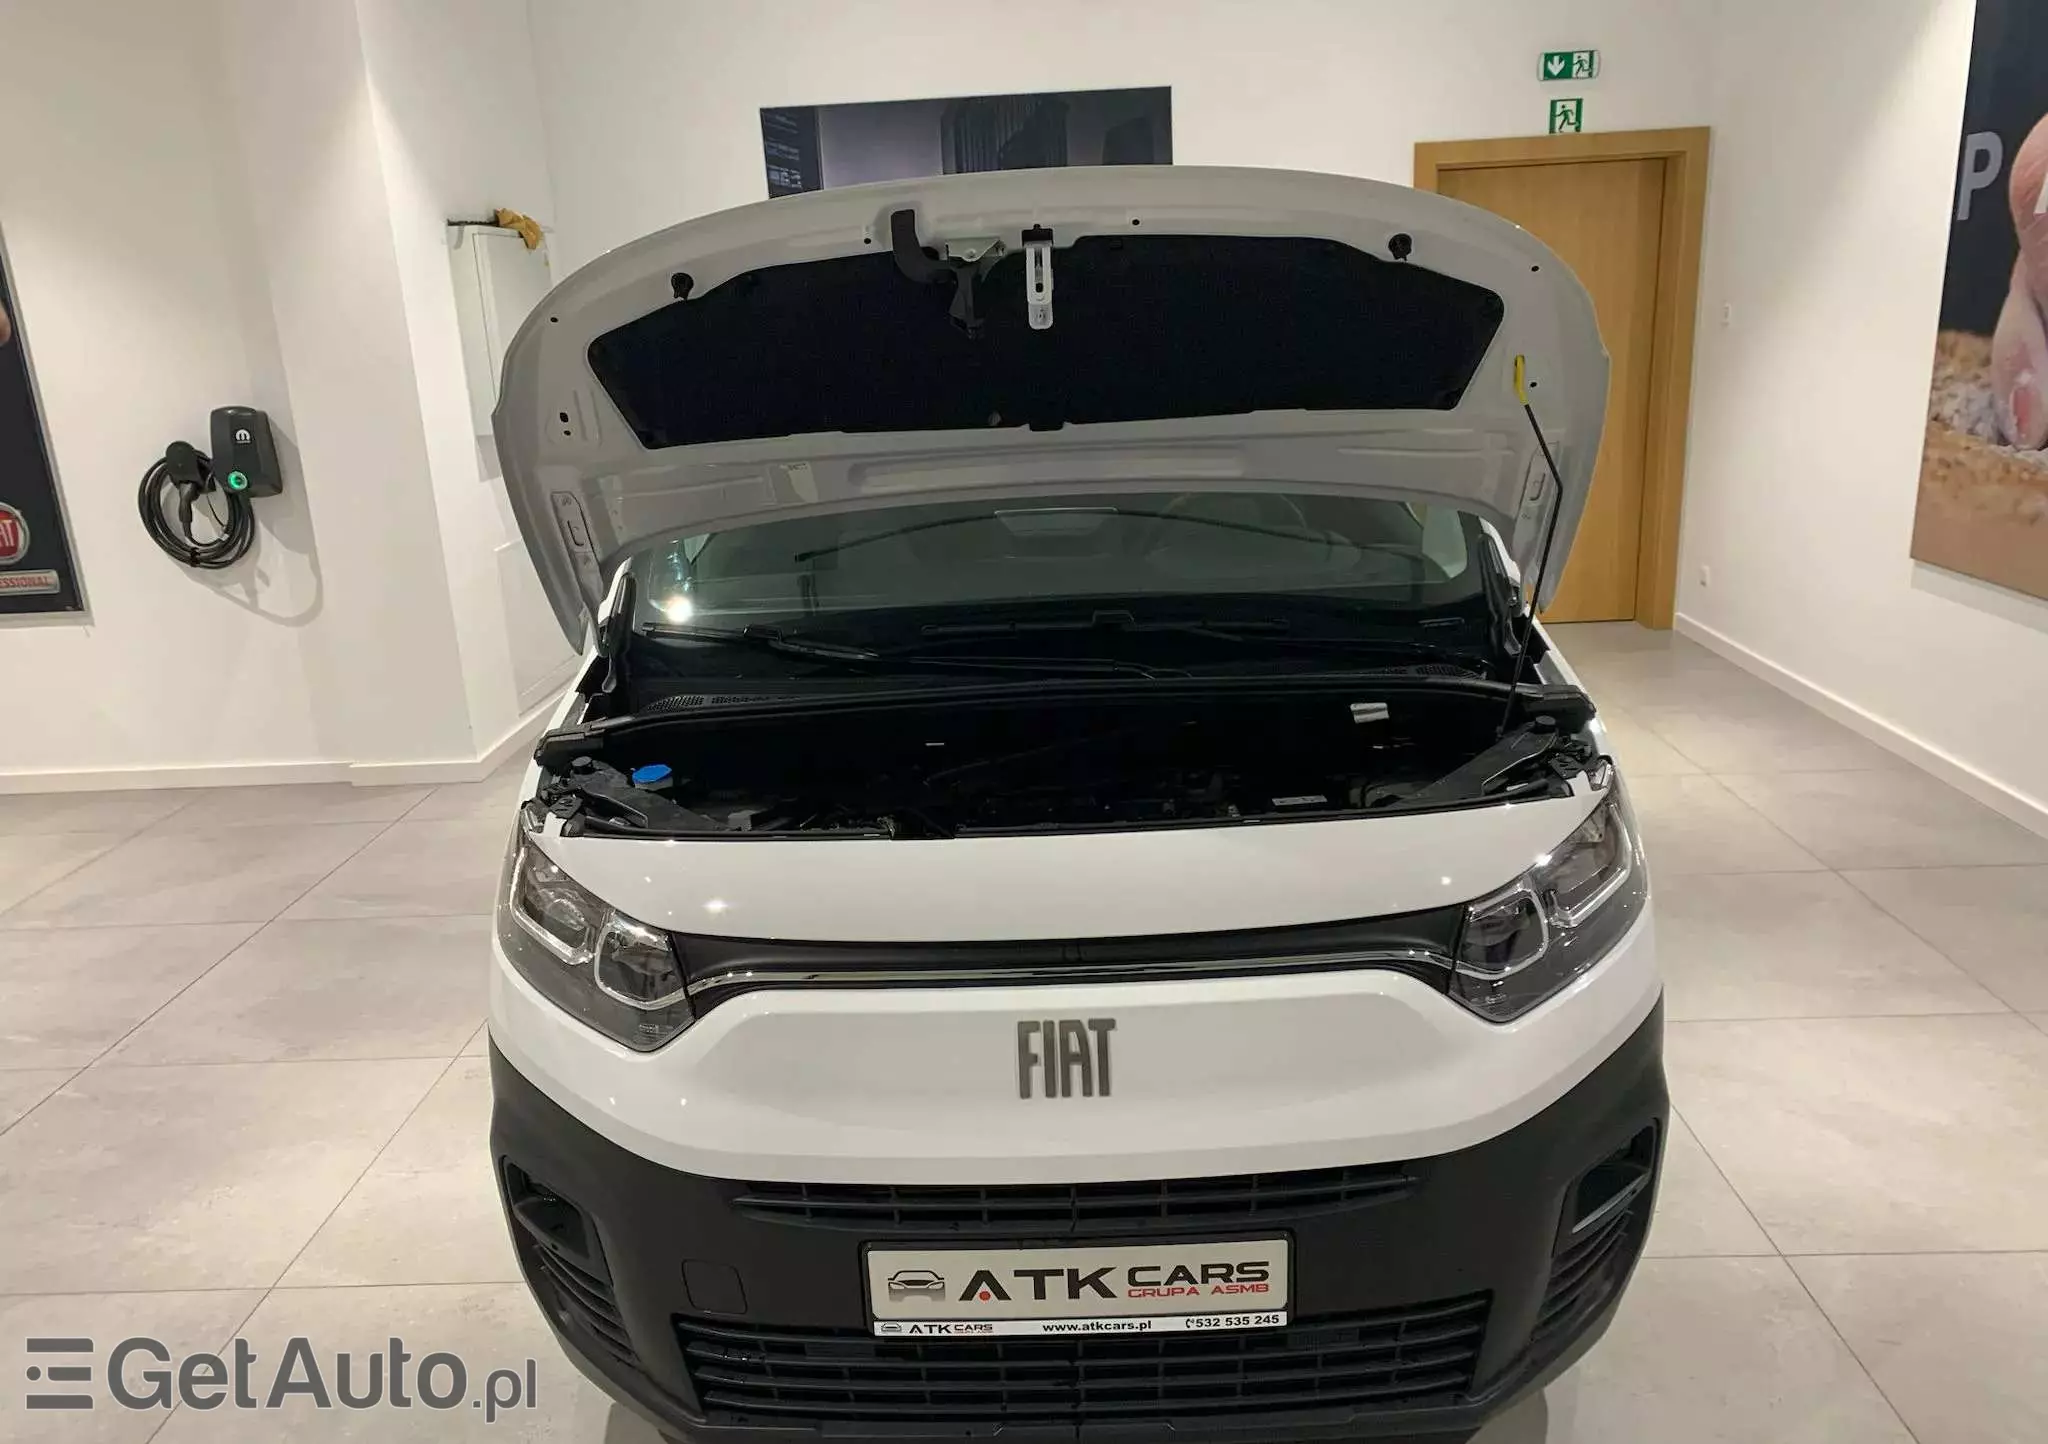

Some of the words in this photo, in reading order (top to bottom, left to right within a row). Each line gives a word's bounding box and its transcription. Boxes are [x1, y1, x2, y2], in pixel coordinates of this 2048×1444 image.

[1017, 1018, 1117, 1099] FIAT
[958, 1267, 1117, 1301] ATK
[1127, 1261, 1270, 1286] CARS
[1127, 1286, 1200, 1298] GRUPA
[1211, 1283, 1270, 1295] ASMB
[1042, 1320, 1152, 1332] www.atkcars.pl
[1196, 1315, 1220, 1327] 532
[1225, 1314, 1250, 1326] 535
[1255, 1313, 1279, 1324] 245
[909, 1323, 952, 1334] ATK
[953, 1323, 993, 1331] CARS
